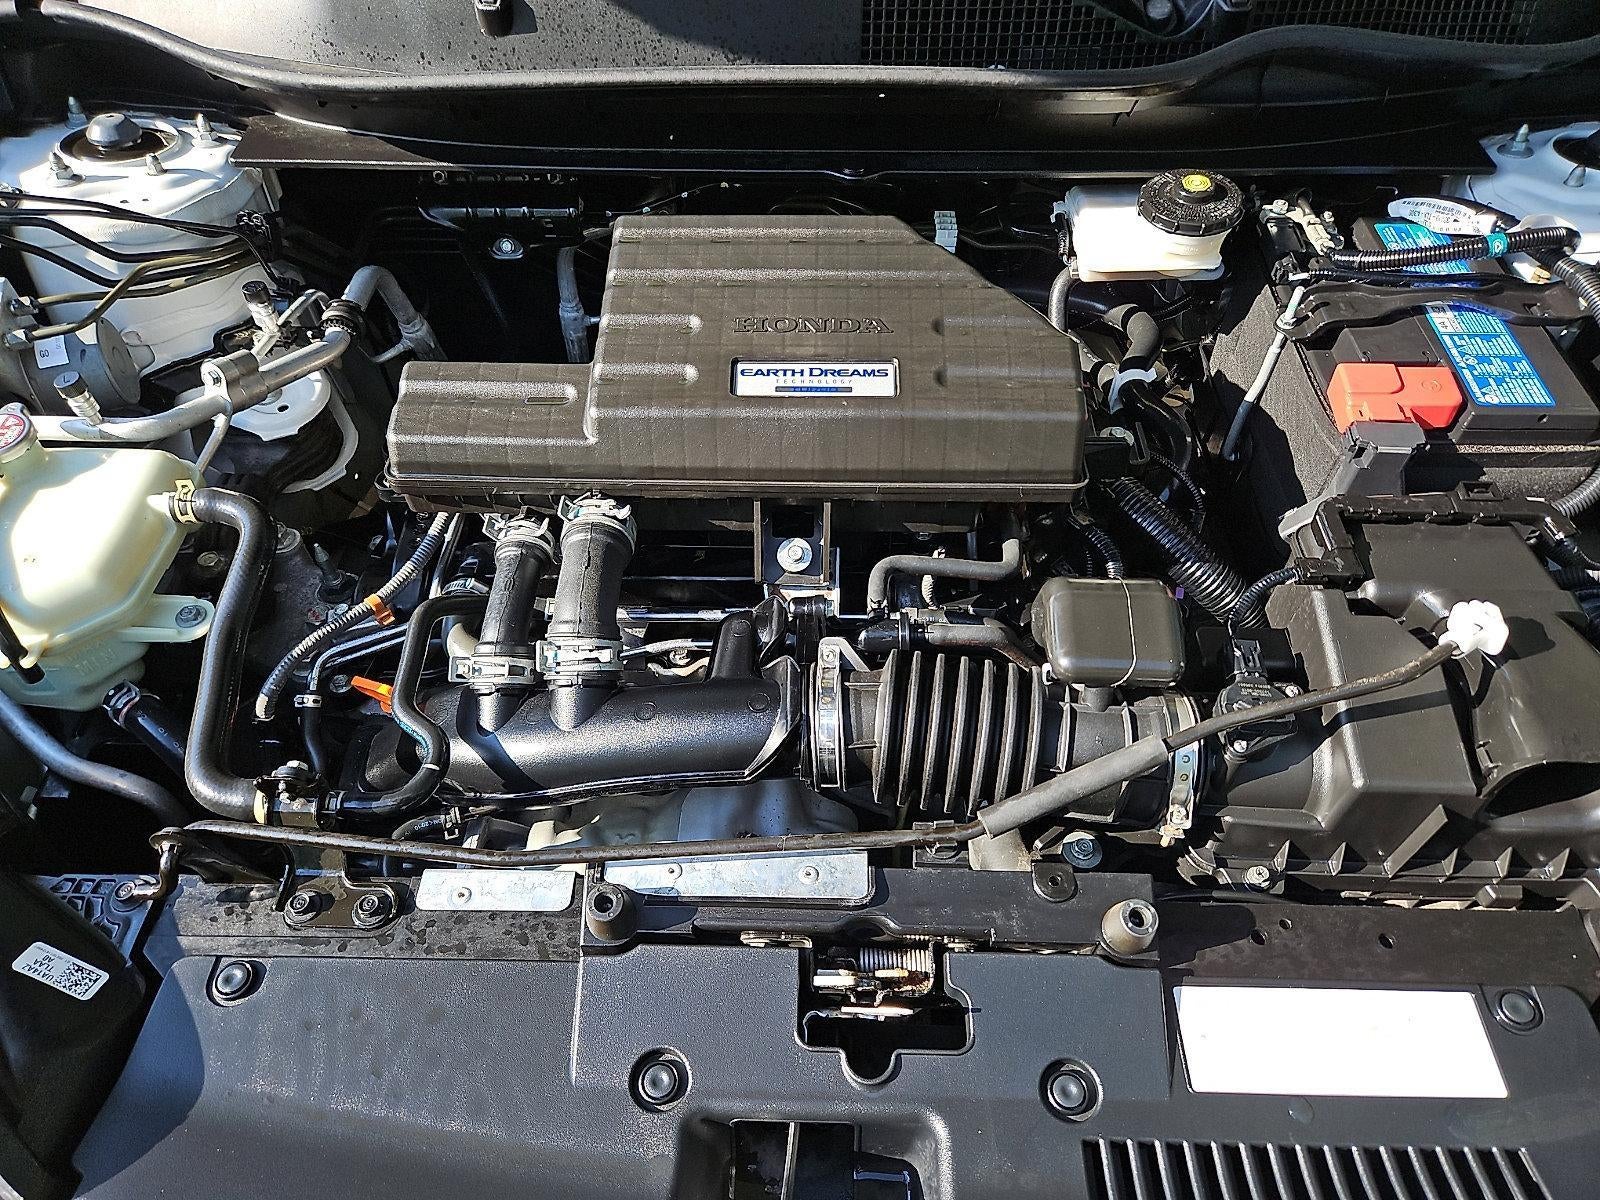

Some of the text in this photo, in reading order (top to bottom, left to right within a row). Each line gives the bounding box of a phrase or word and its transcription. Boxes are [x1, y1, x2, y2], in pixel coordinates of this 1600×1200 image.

[733, 316, 894, 333] HONDA
[740, 367, 889, 377] EARTH DREAMS
[33, 958, 54, 972] TLAA
